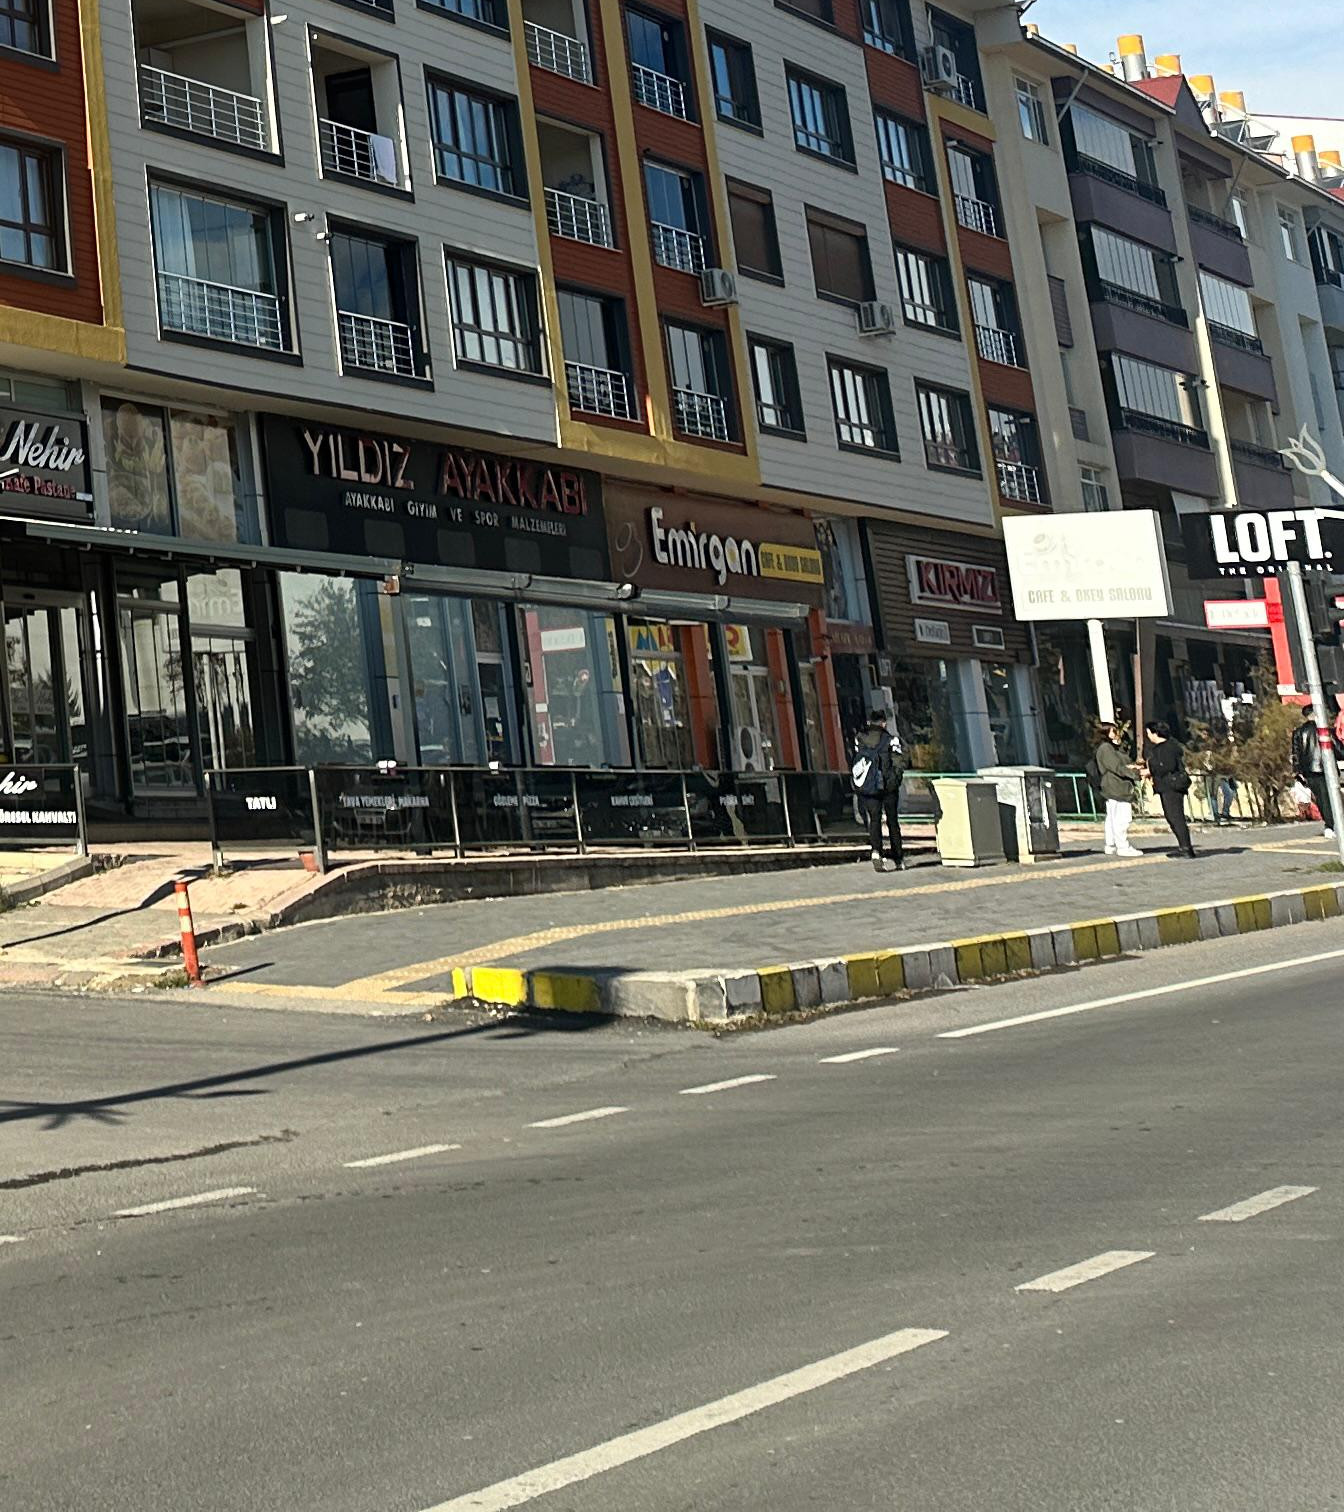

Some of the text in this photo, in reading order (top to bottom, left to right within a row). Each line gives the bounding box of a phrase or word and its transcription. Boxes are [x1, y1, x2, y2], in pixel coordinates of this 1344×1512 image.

[303, 429, 588, 516] YILDIZ AYAKKABI
[33, 475, 77, 499] Pastane
[345, 491, 395, 513] AYAKKABI
[450, 507, 463, 522] VE
[474, 509, 500, 527] SPOR
[650, 505, 759, 587] Emirgan
[1218, 563, 1333, 576] THE ORINAL
[1060, 589, 1071, 603] &
[245, 796, 277, 810] TATLI
